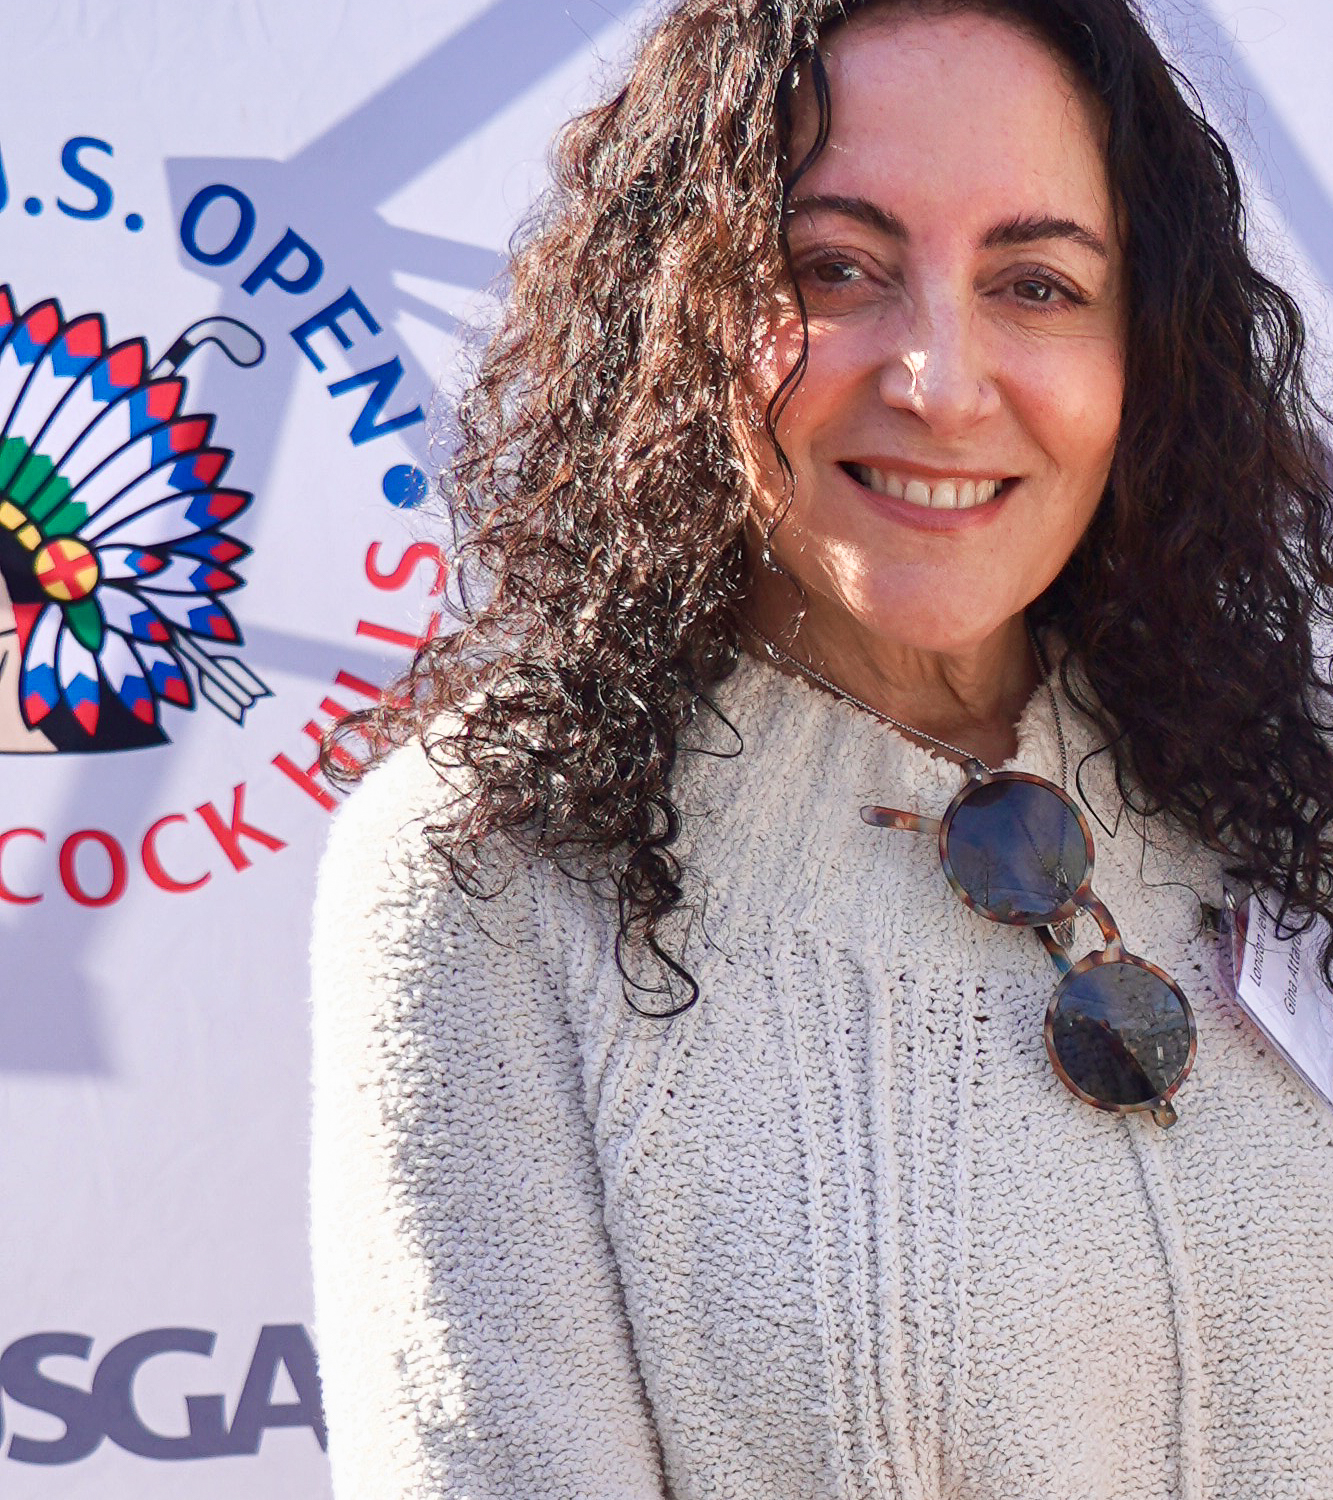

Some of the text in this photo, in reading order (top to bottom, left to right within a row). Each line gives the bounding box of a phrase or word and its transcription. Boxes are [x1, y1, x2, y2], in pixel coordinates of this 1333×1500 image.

[179, 183, 427, 448] OPEN
[1283, 980, 1298, 1016] Gina
[0, 1324, 328, 1466] SGA
